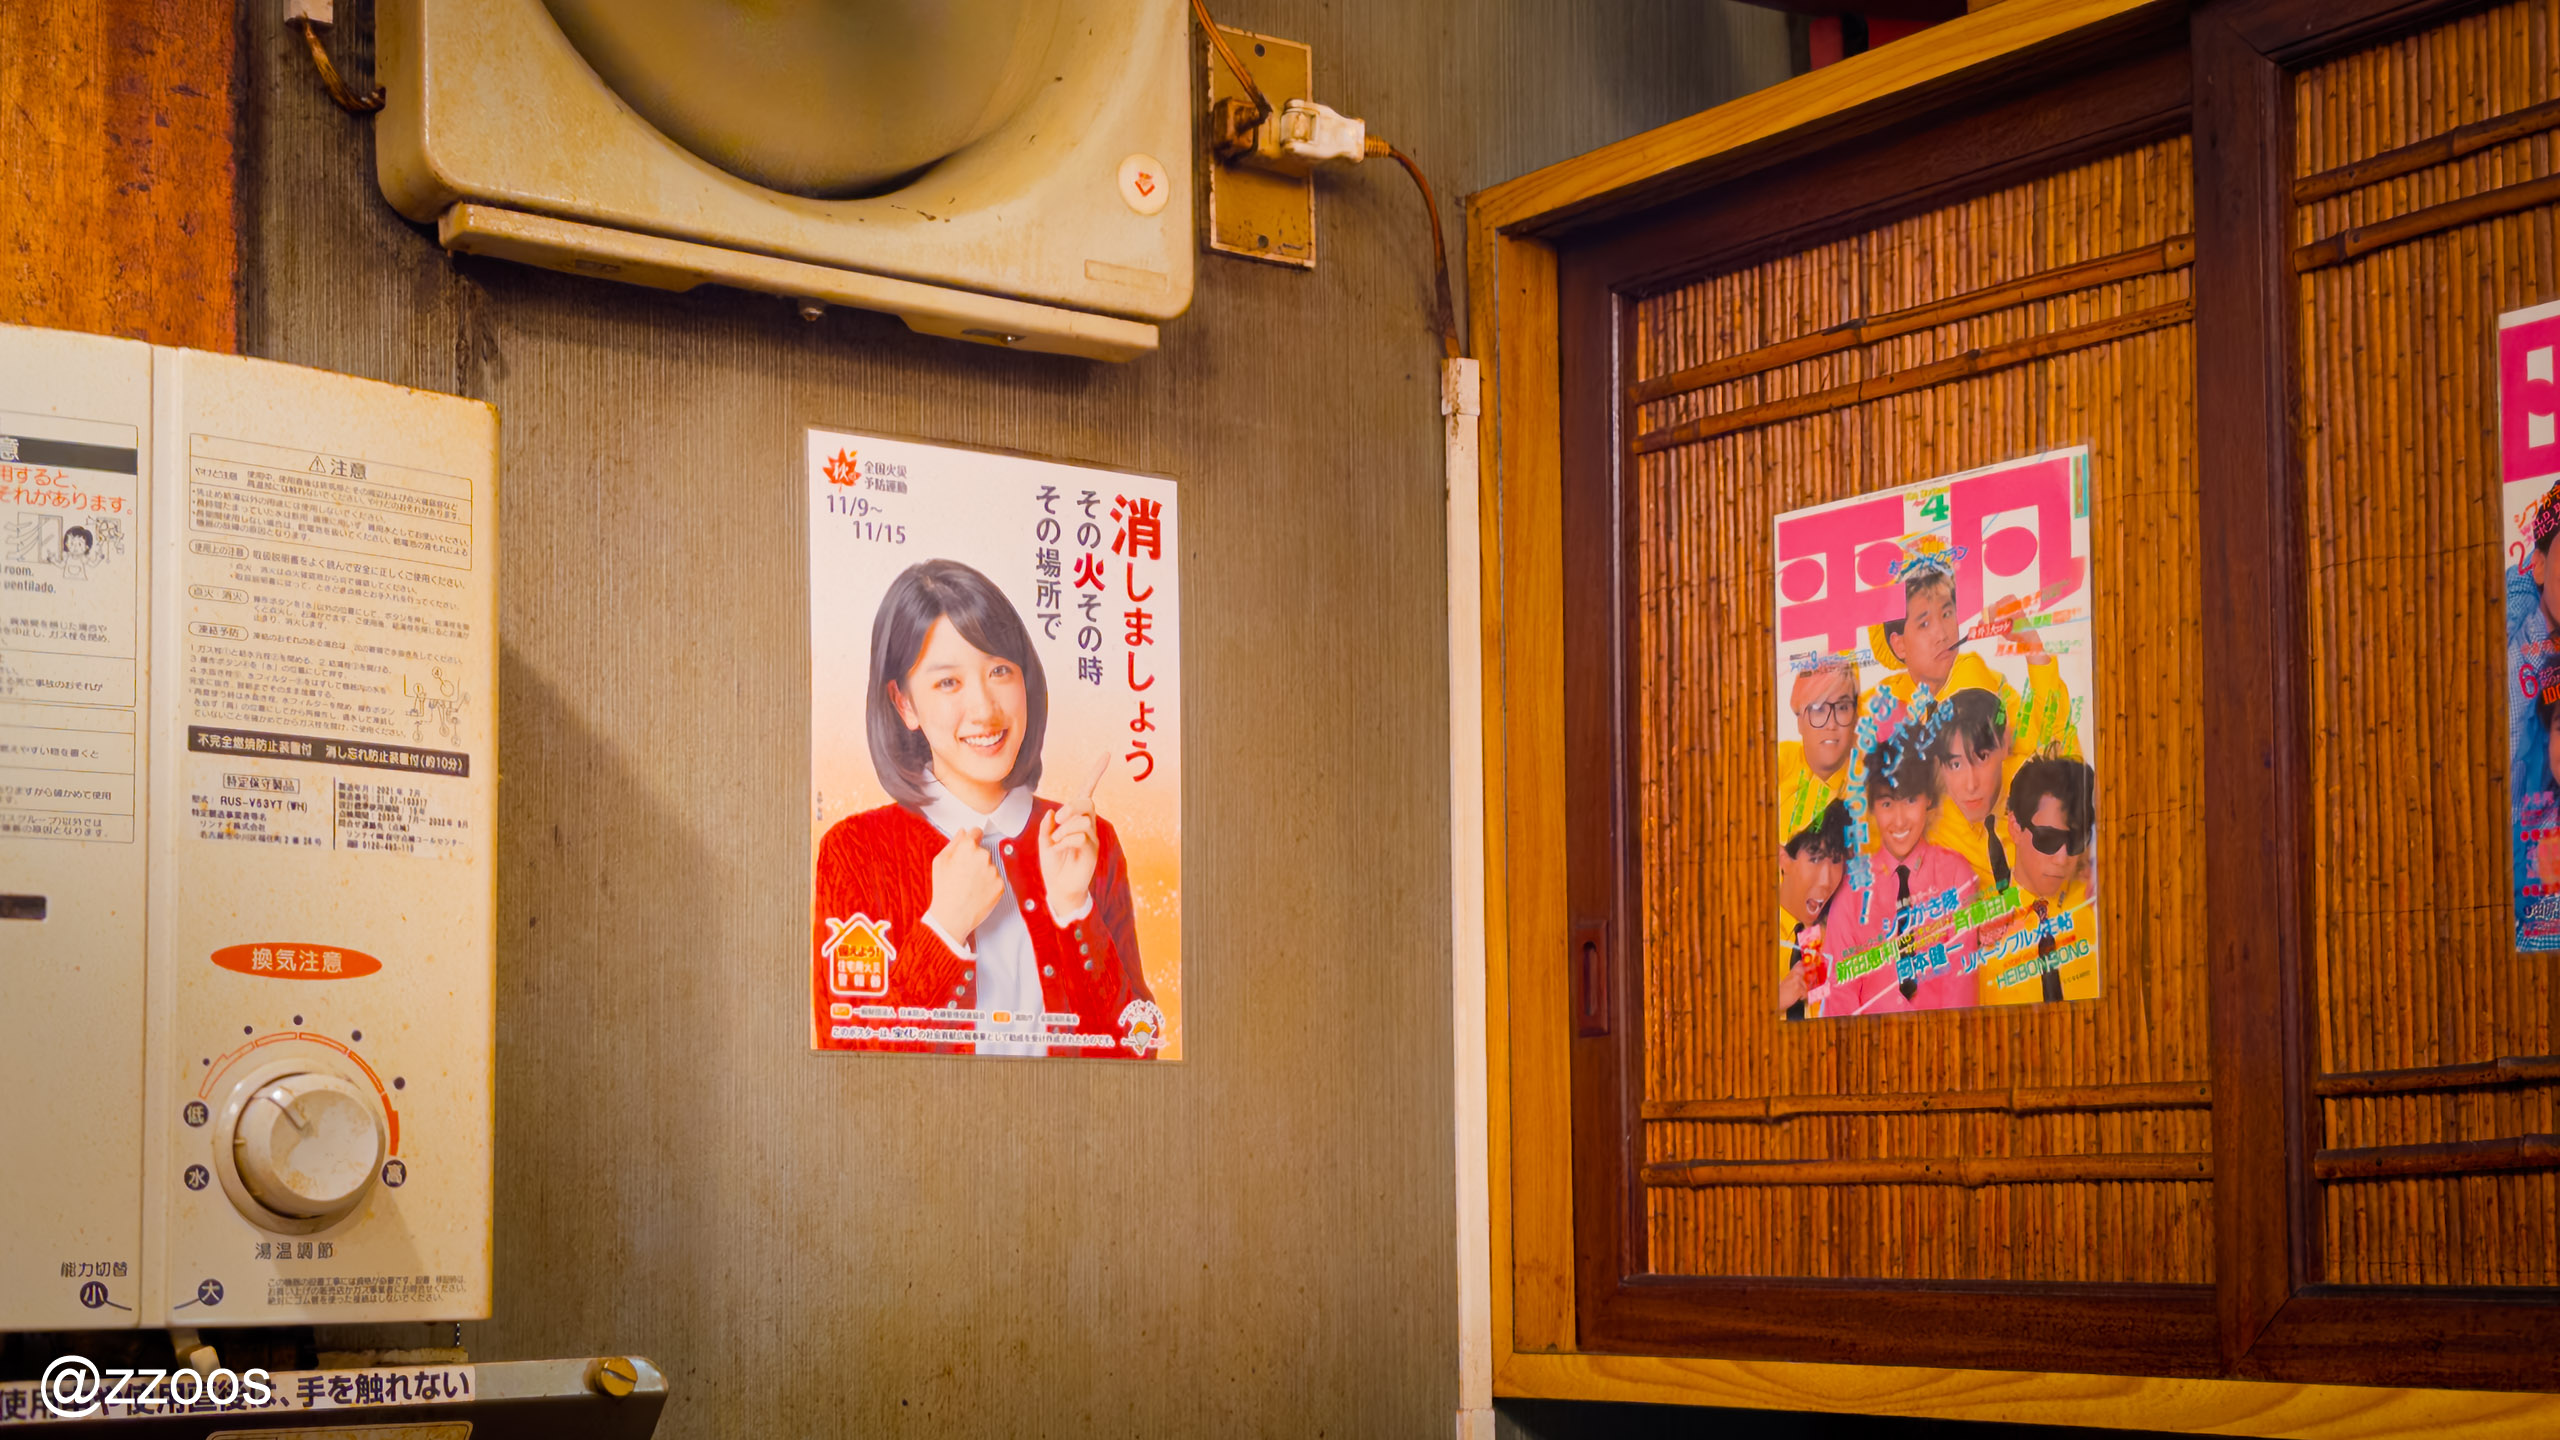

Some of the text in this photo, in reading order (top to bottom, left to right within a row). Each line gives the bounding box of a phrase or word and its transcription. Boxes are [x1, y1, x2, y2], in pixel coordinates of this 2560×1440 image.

[330, 458, 367, 480] 注意
[865, 460, 907, 478] 全国火災
[865, 477, 908, 494] 予防運動
[1920, 493, 1949, 522] 4
[853, 520, 906, 544] 11/15
[1036, 485, 1062, 640] その場所で
[2509, 541, 2535, 575] 2
[1074, 490, 1105, 686] その火その時
[1110, 494, 1162, 782] 消しましょう
[2519, 663, 2539, 699] 6
[226, 775, 295, 792] 特定保守製品
[252, 947, 343, 974] 換気注意
[188, 1168, 206, 1188] 水
[255, 1242, 333, 1260] 湯温調節
[61, 1261, 128, 1278] 能力切替
[84, 1284, 104, 1306] 小
[200, 1282, 221, 1302] 大
